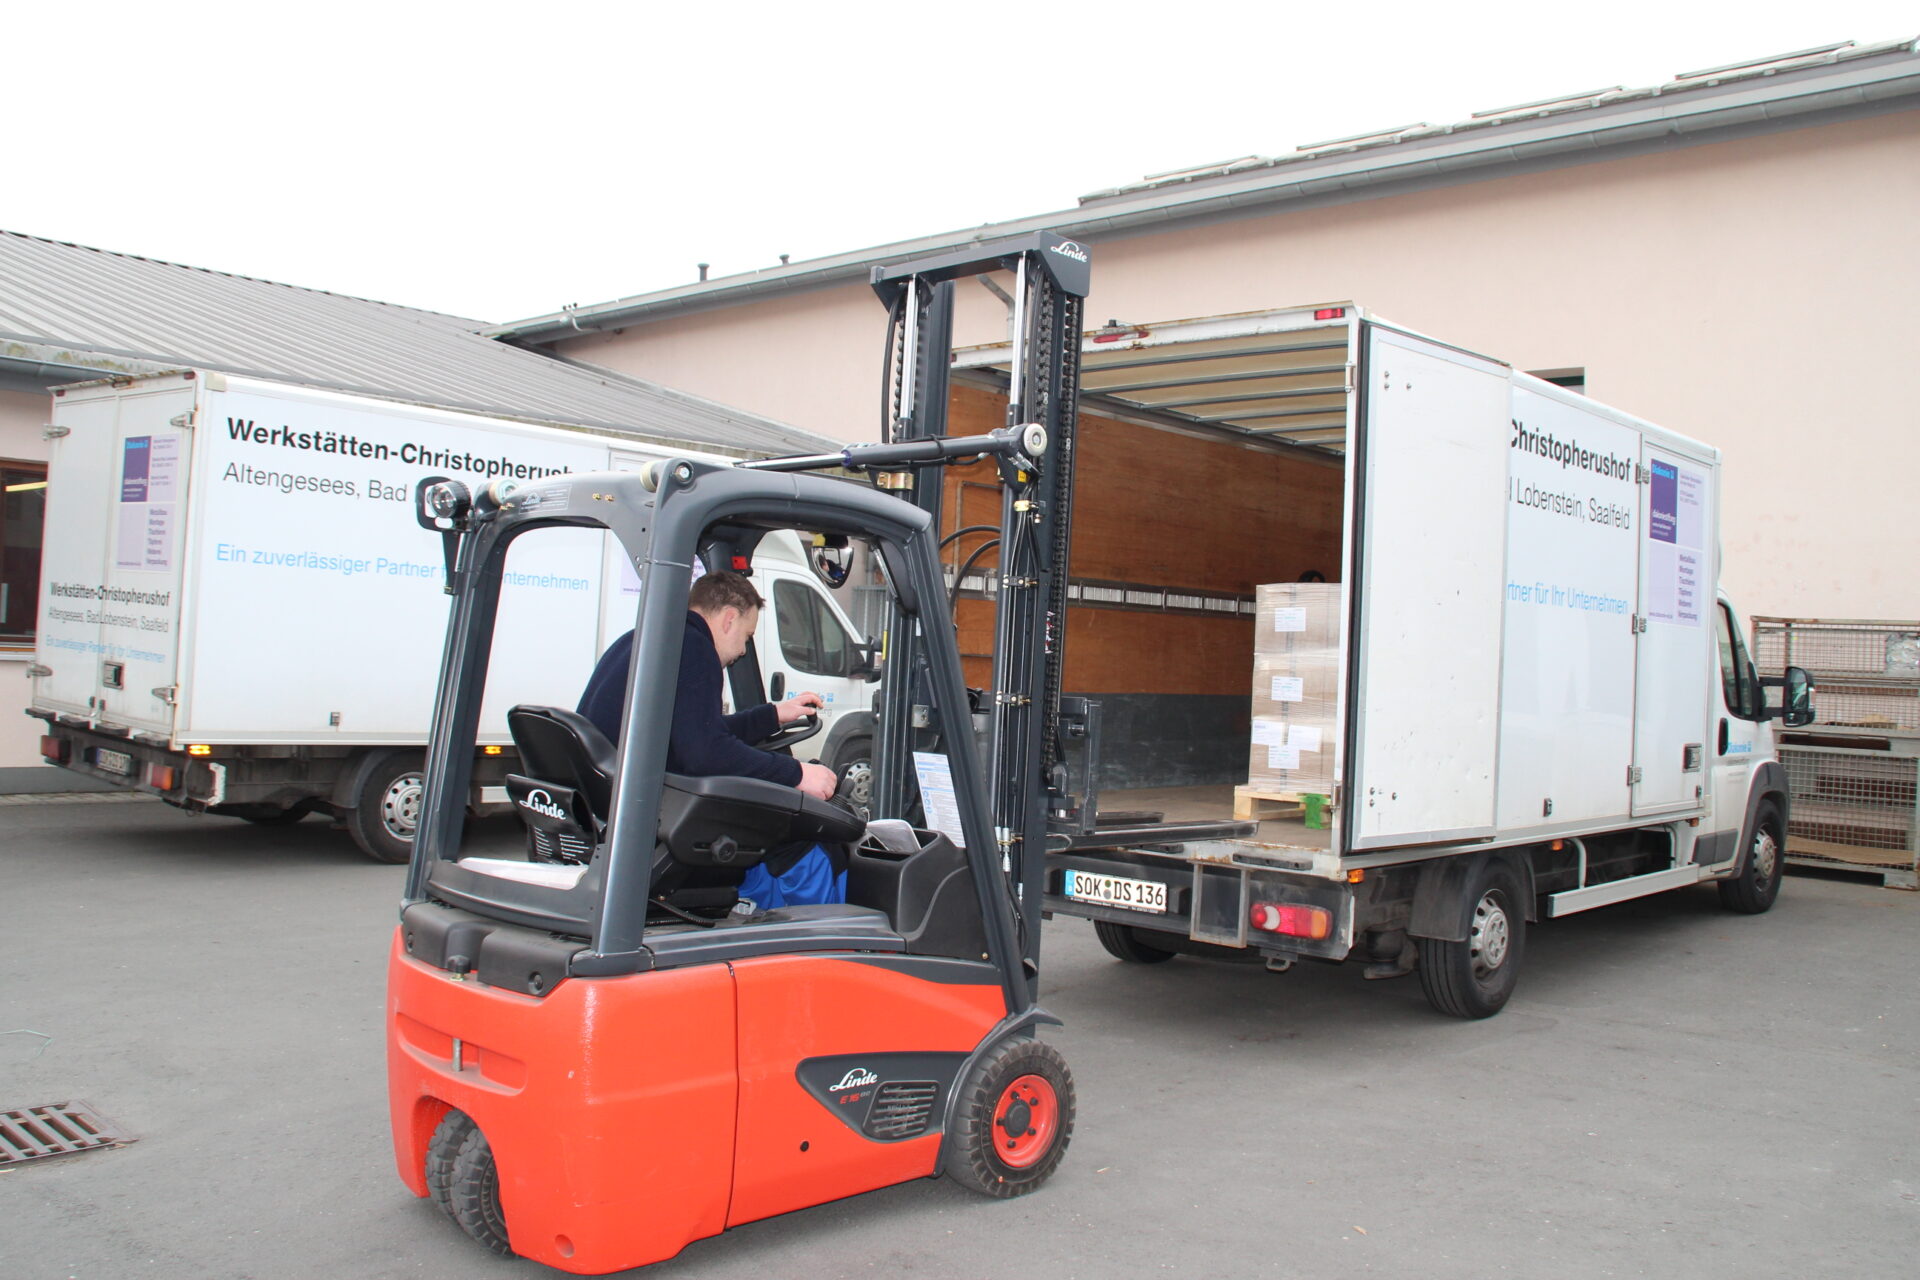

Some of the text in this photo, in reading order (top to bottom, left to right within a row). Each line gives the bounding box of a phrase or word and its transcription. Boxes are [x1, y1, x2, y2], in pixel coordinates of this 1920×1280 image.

[1050, 241, 1088, 262] Linde
[223, 462, 408, 502] Altengesees, Bad
[1517, 478, 1586, 524] Lobenstein,
[1589, 497, 1630, 530] Saalfeld
[216, 543, 247, 563] Ein
[252, 550, 371, 576] zuverlässiger
[376, 557, 437, 579] Partner
[503, 571, 589, 591] nternehmen
[1507, 580, 1628, 614] rtner für Ihr Unternehmen
[519, 788, 567, 820] Linde
[1075, 875, 1102, 897] SOK
[1113, 881, 1131, 901] DS
[1136, 884, 1163, 906] 136
[829, 1067, 878, 1092] Linde
